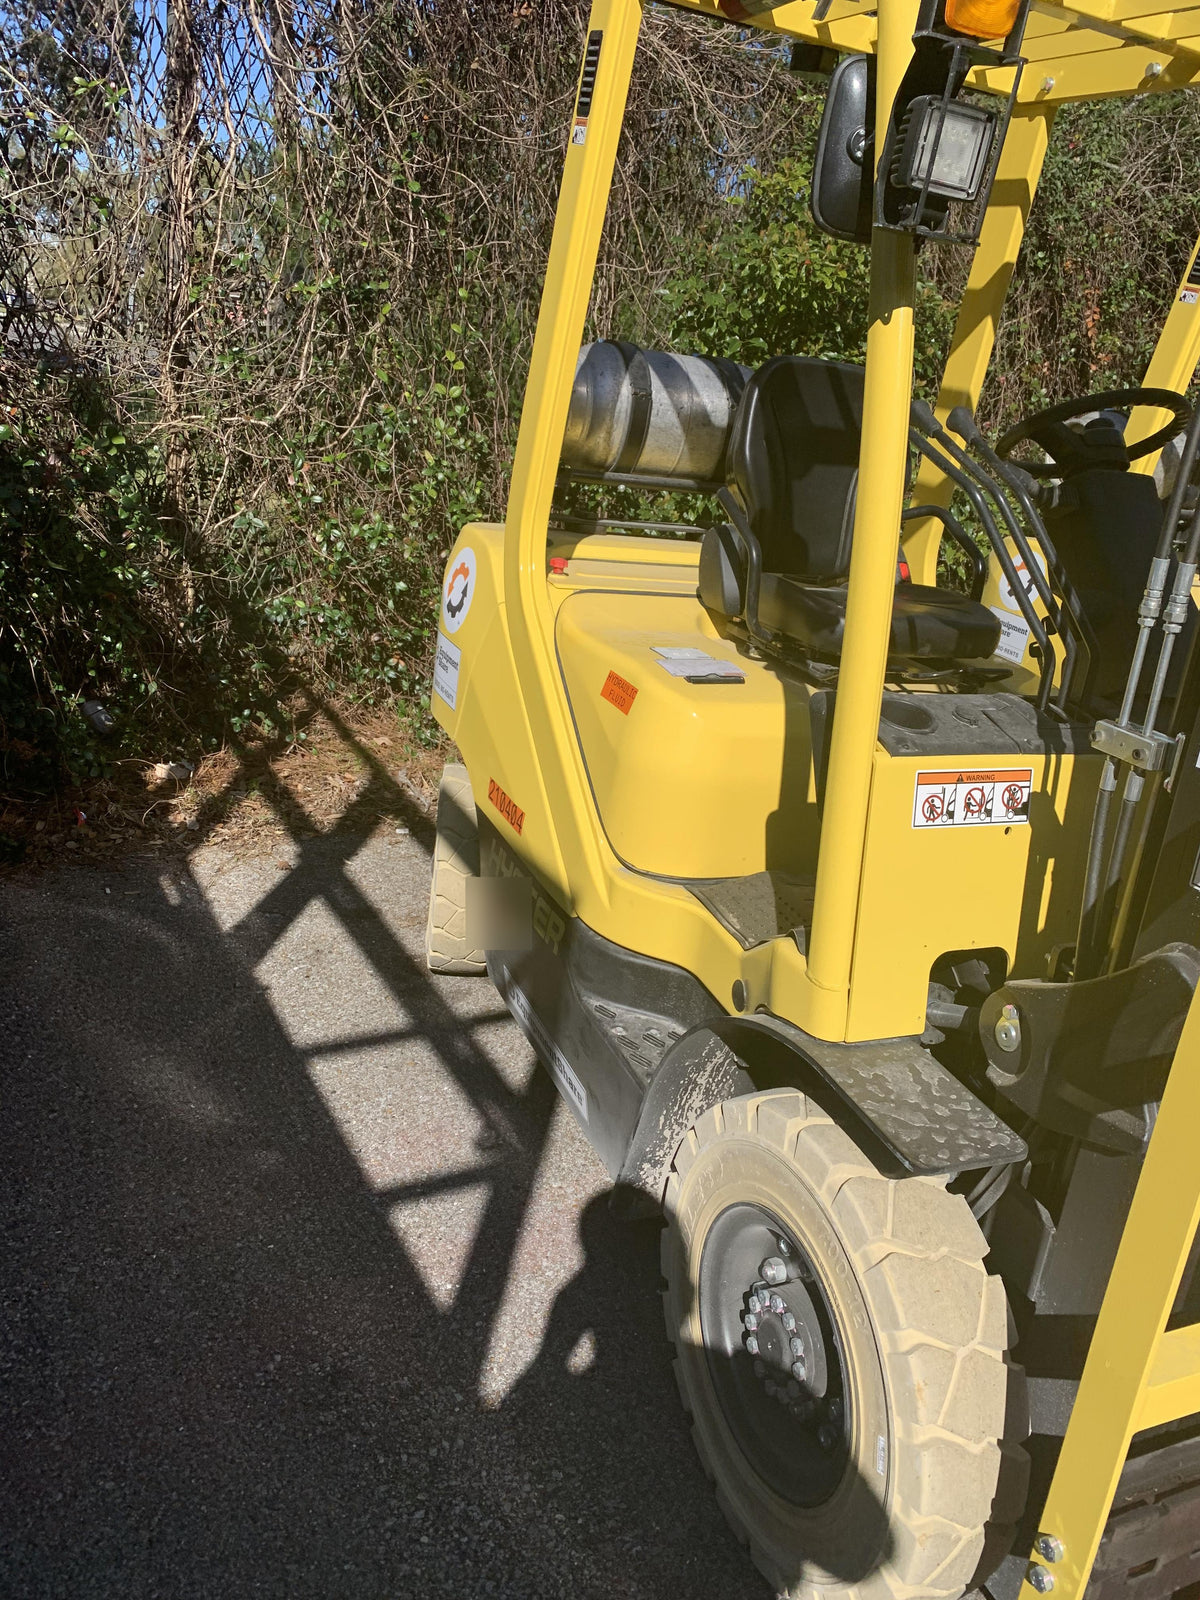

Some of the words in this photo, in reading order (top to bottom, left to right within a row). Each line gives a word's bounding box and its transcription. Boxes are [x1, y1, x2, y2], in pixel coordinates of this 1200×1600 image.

[607, 671, 638, 700] HYDRAULIC
[609, 688, 626, 707] FLUID
[966, 774, 996, 782] WARNING
[488, 779, 525, 833] 210404
[488, 838, 566, 956] HYER
